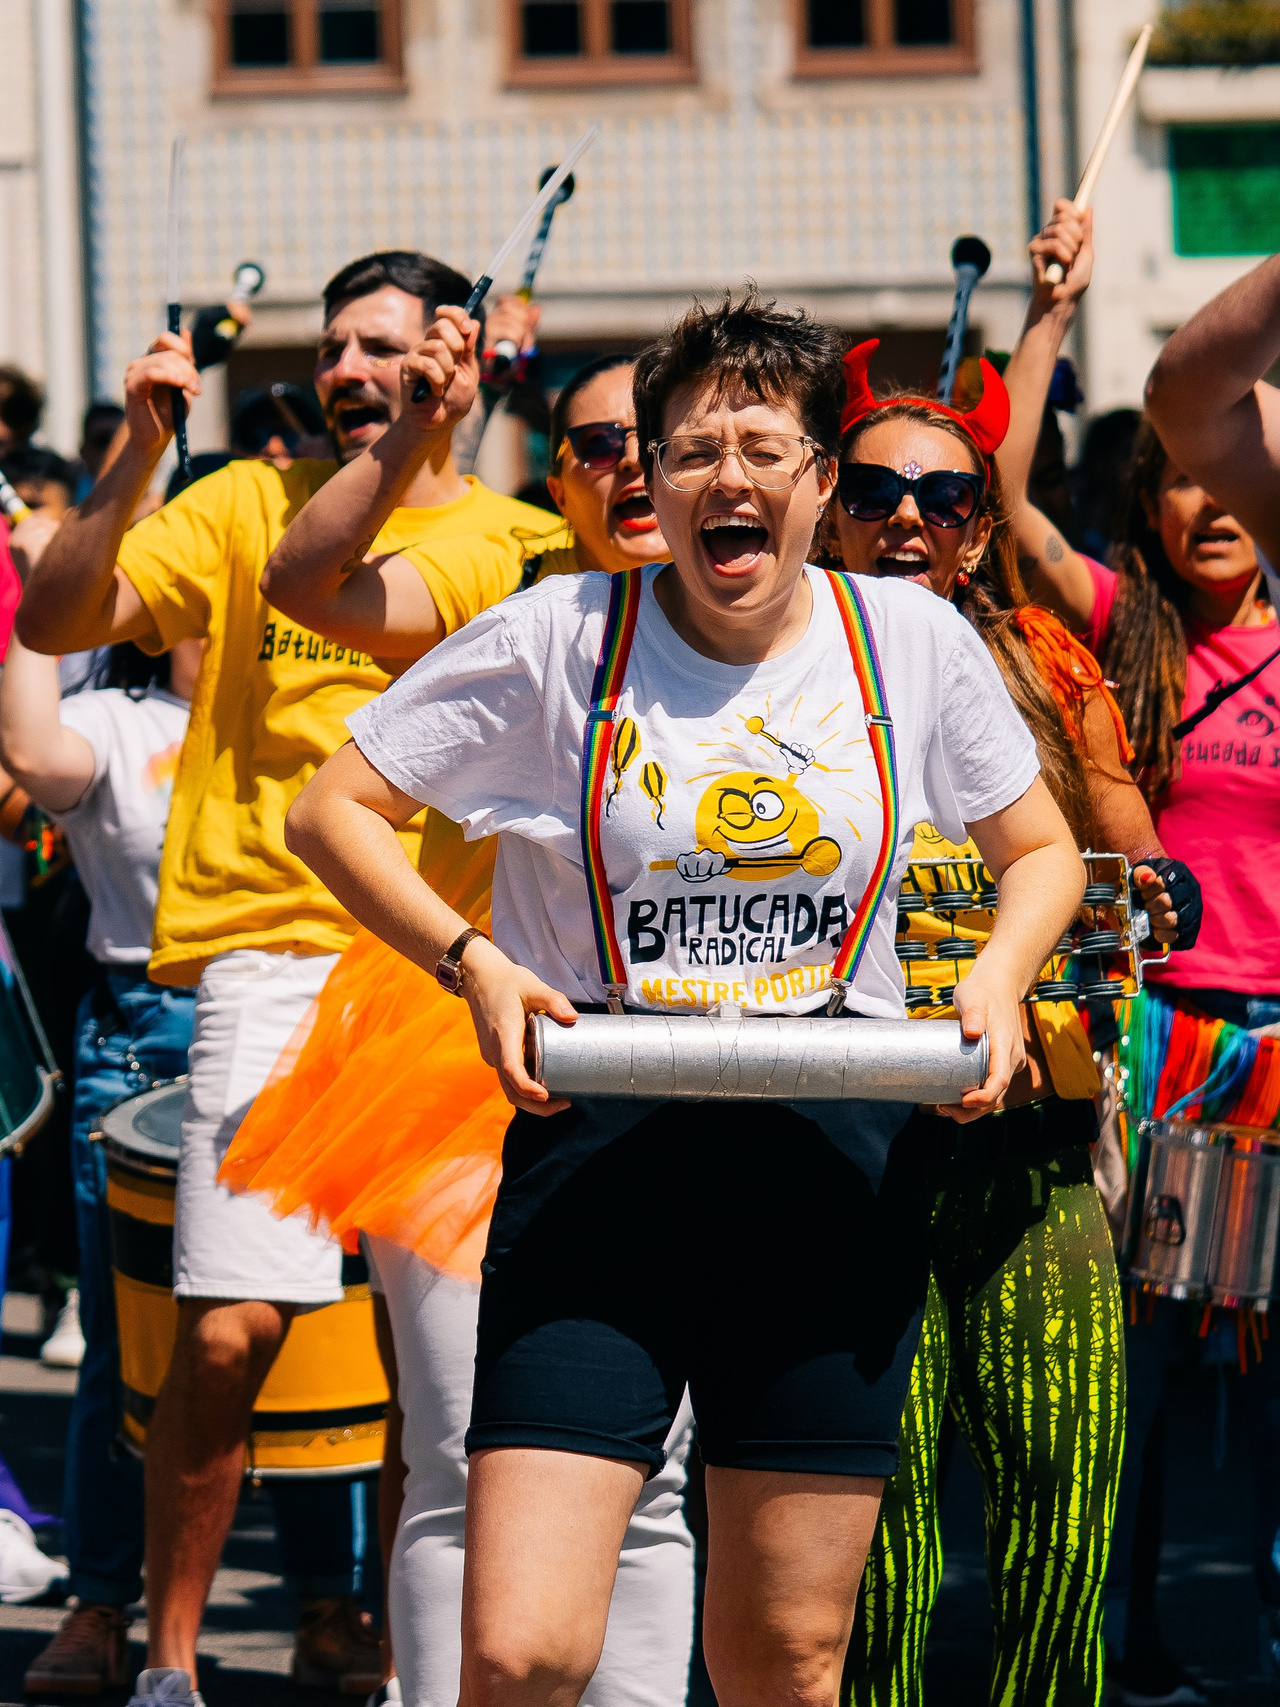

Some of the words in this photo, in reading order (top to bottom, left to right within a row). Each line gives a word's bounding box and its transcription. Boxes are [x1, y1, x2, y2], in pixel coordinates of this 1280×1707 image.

[1184, 741, 1261, 767] tucada
[628, 893, 849, 964] BATUCADA
[688, 933, 787, 965] RADICAL
[641, 978, 748, 1008] MESTRE
